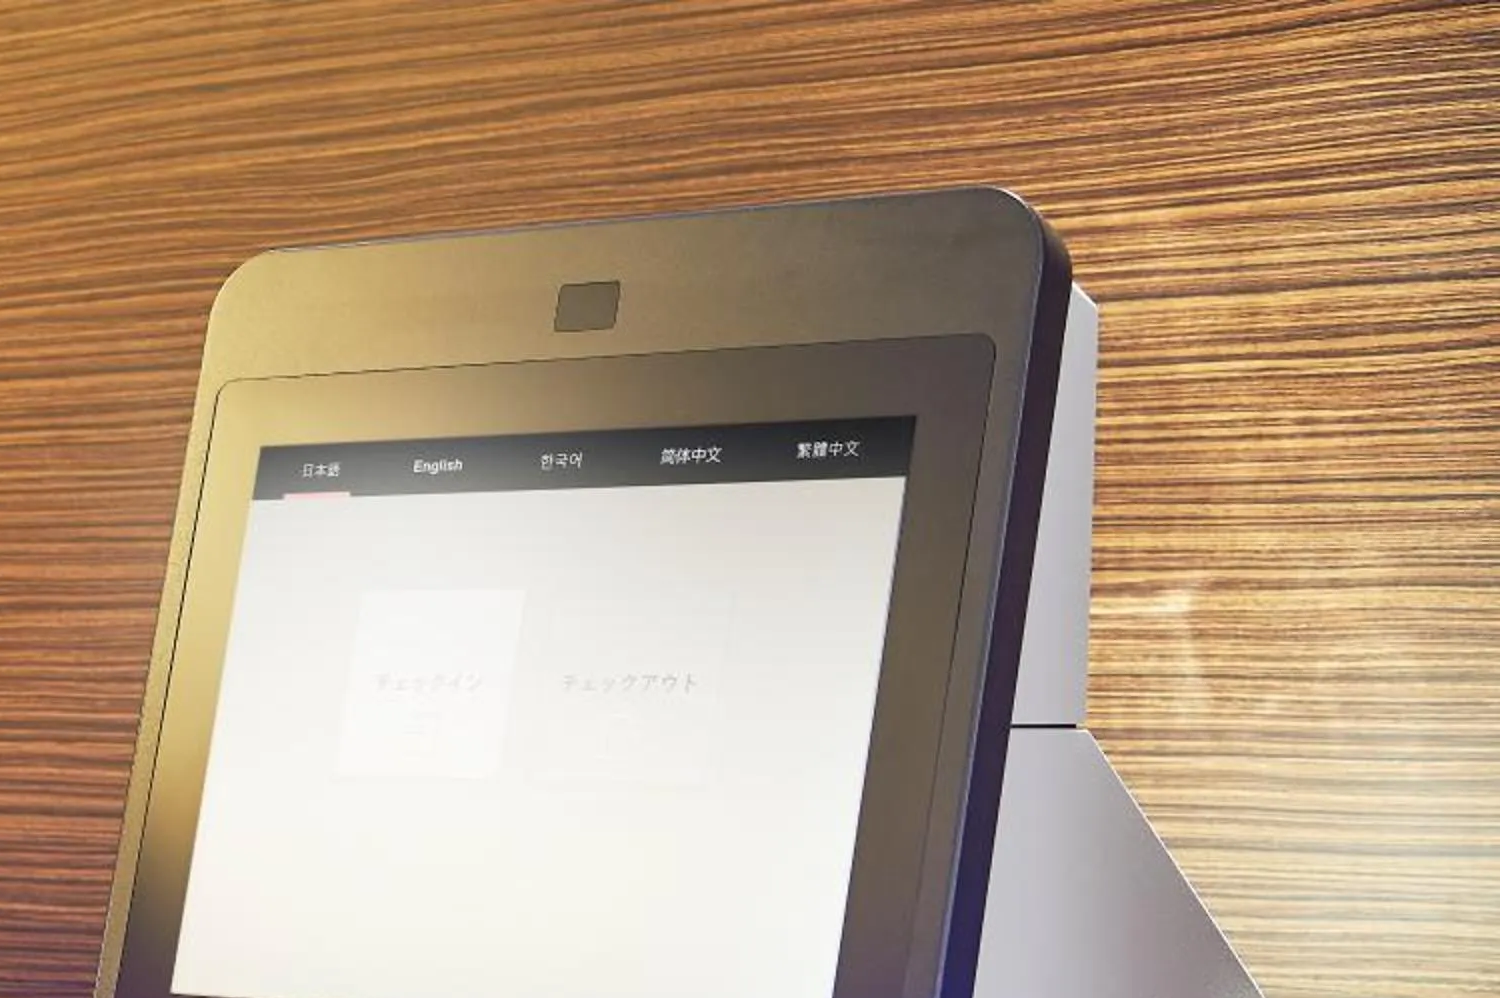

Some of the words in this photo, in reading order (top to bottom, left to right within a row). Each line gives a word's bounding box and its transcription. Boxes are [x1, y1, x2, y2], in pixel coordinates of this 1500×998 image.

[412, 457, 464, 476] English
[540, 451, 584, 471] 한국어
[560, 671, 699, 695] チェックアウト
